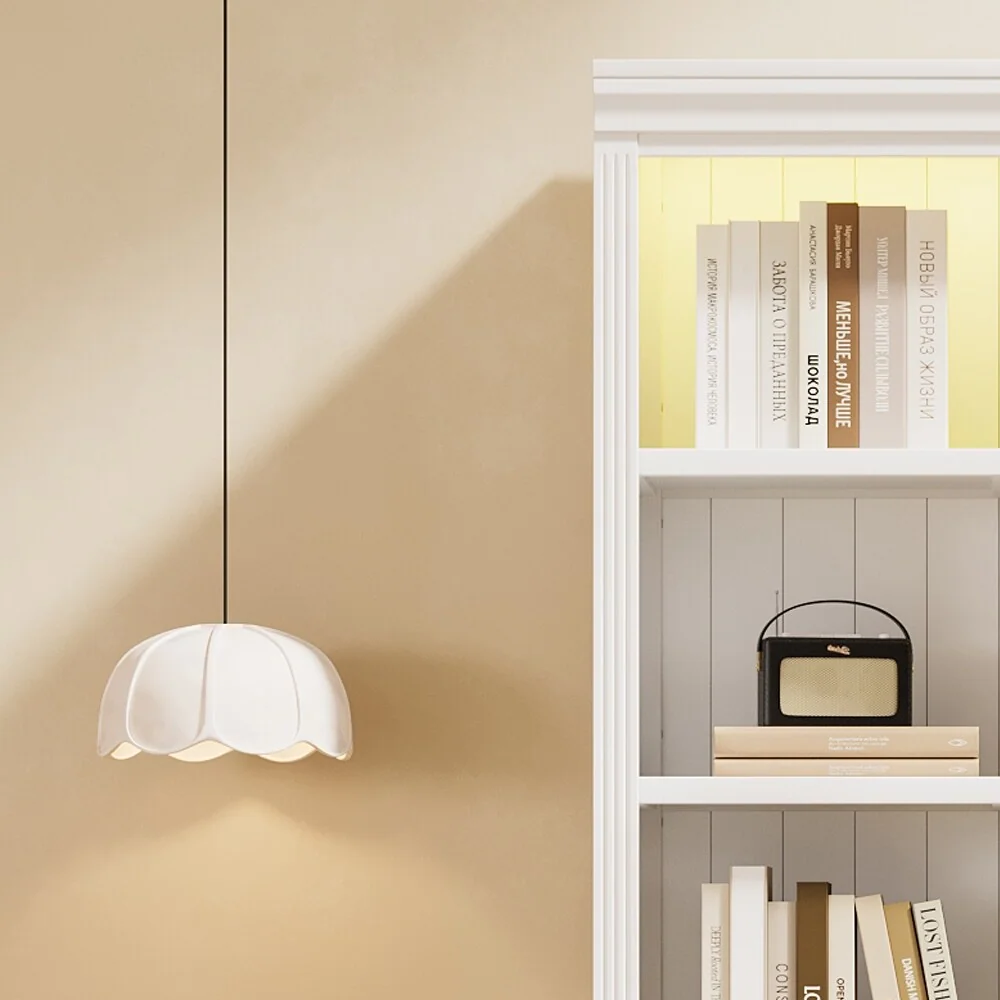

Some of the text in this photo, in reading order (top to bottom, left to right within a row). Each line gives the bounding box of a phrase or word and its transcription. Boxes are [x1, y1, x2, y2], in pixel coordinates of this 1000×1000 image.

[809, 225, 817, 310] АНАСТАСИЯ БАРАШКОВА
[769, 260, 786, 421] ЗАБОТА О ПРЕДАННЫХ
[920, 240, 938, 419] НОВЫЙ ОБРАЗ ЖИЗНИ
[805, 354, 819, 426] ШОКОЛАД
[835, 381, 851, 427] ЛУЧШЕ
[711, 926, 721, 955] DEEPLY
[901, 958, 917, 992] DANISH
[919, 907, 951, 1000] LOST FISH
[711, 983, 721, 991] IN
